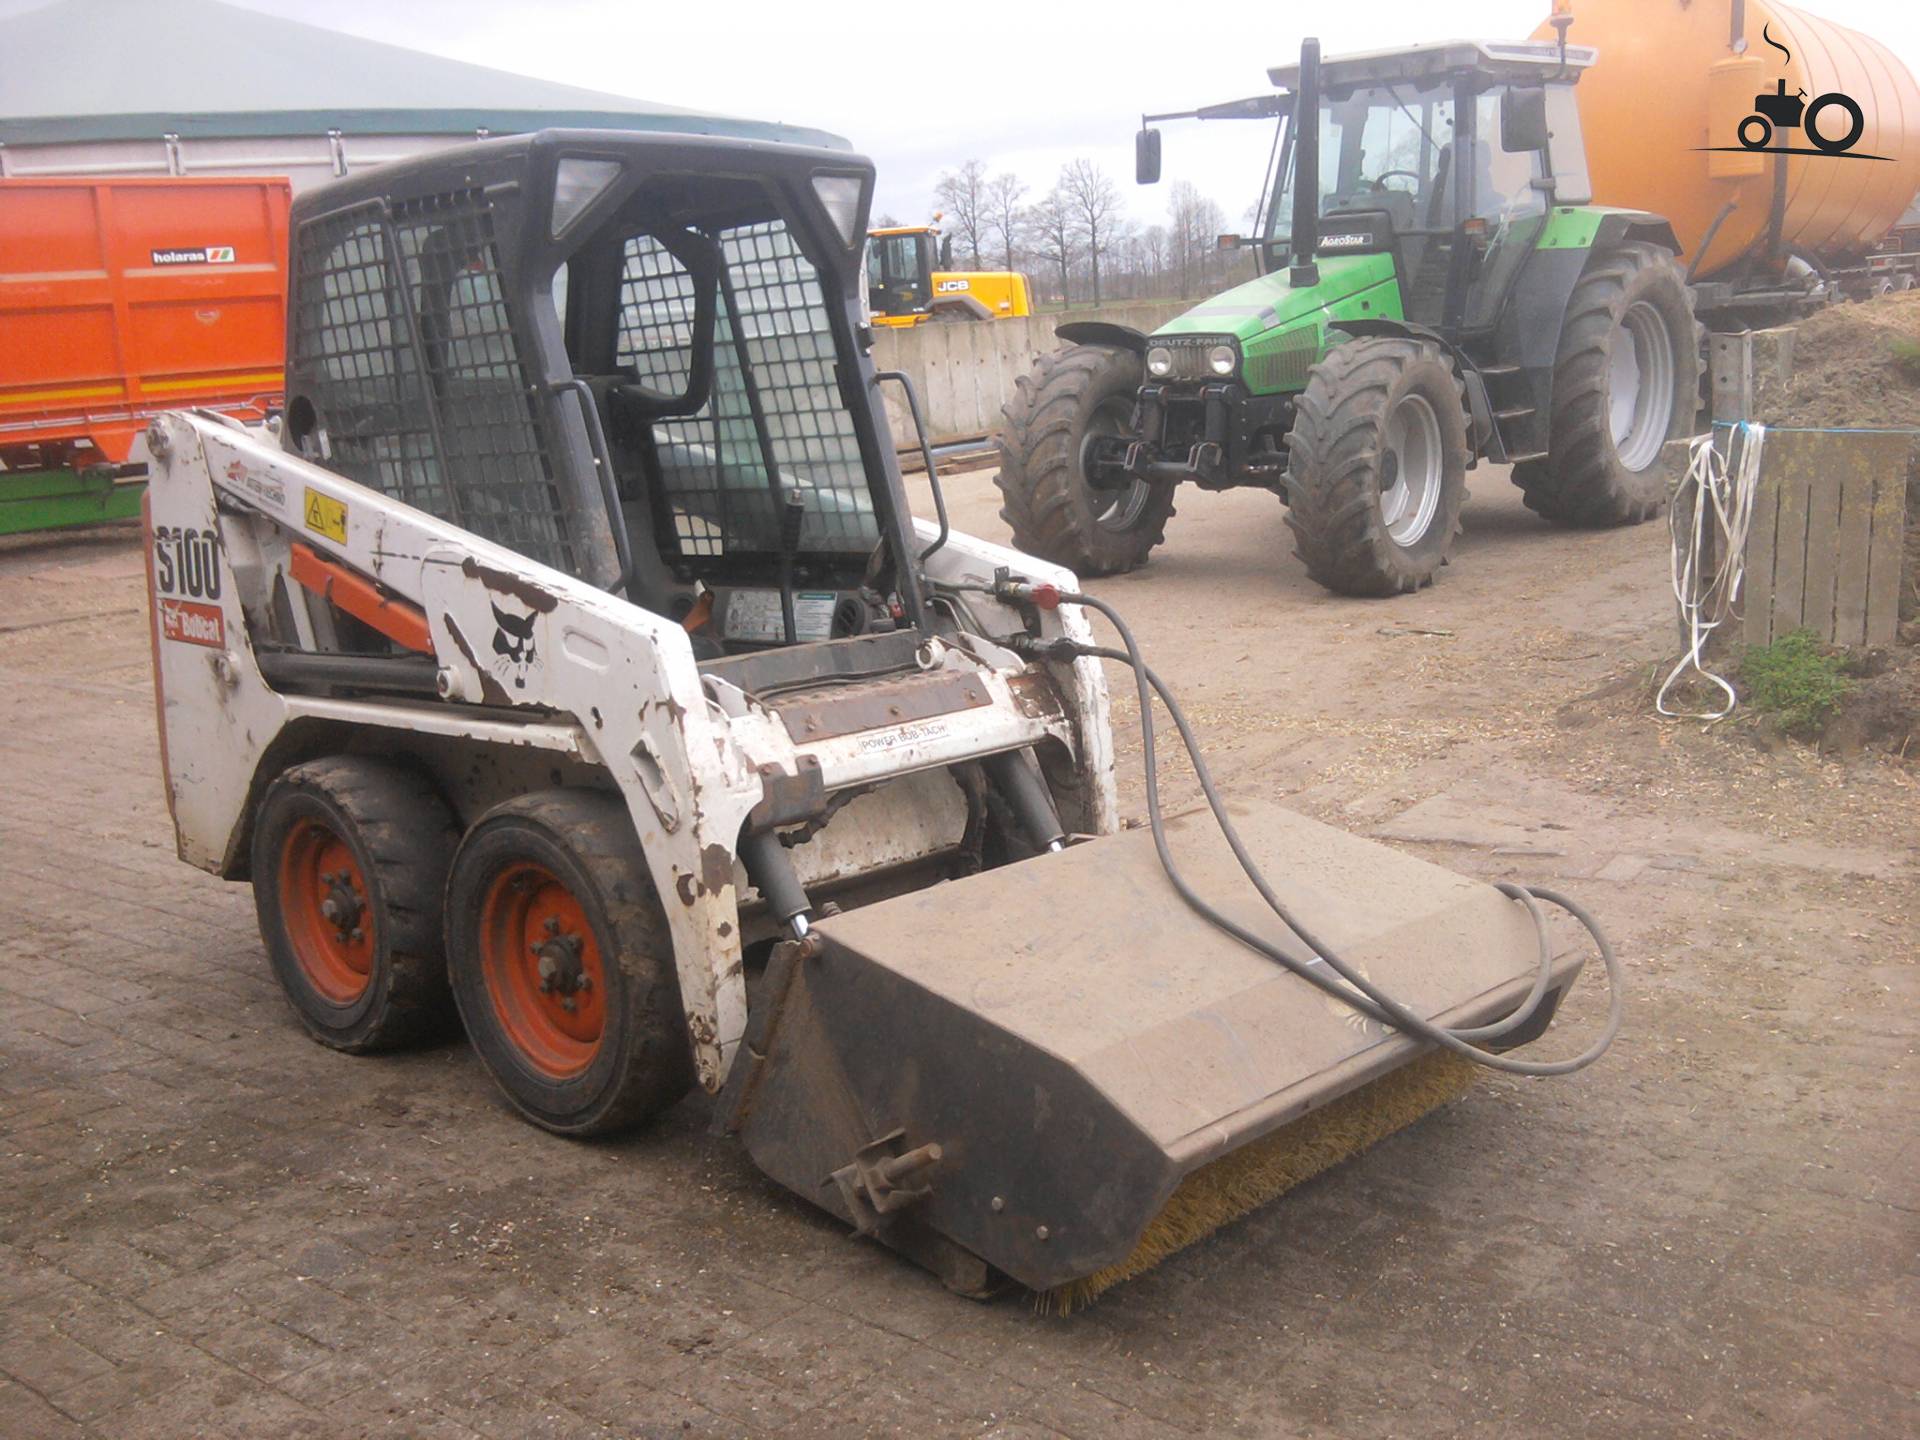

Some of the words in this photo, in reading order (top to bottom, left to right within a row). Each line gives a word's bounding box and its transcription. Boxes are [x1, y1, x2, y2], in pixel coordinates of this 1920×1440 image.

[153, 251, 205, 263] holaras
[937, 280, 969, 292] JCB
[157, 525, 221, 600] S100
[862, 736, 897, 750] POWER
